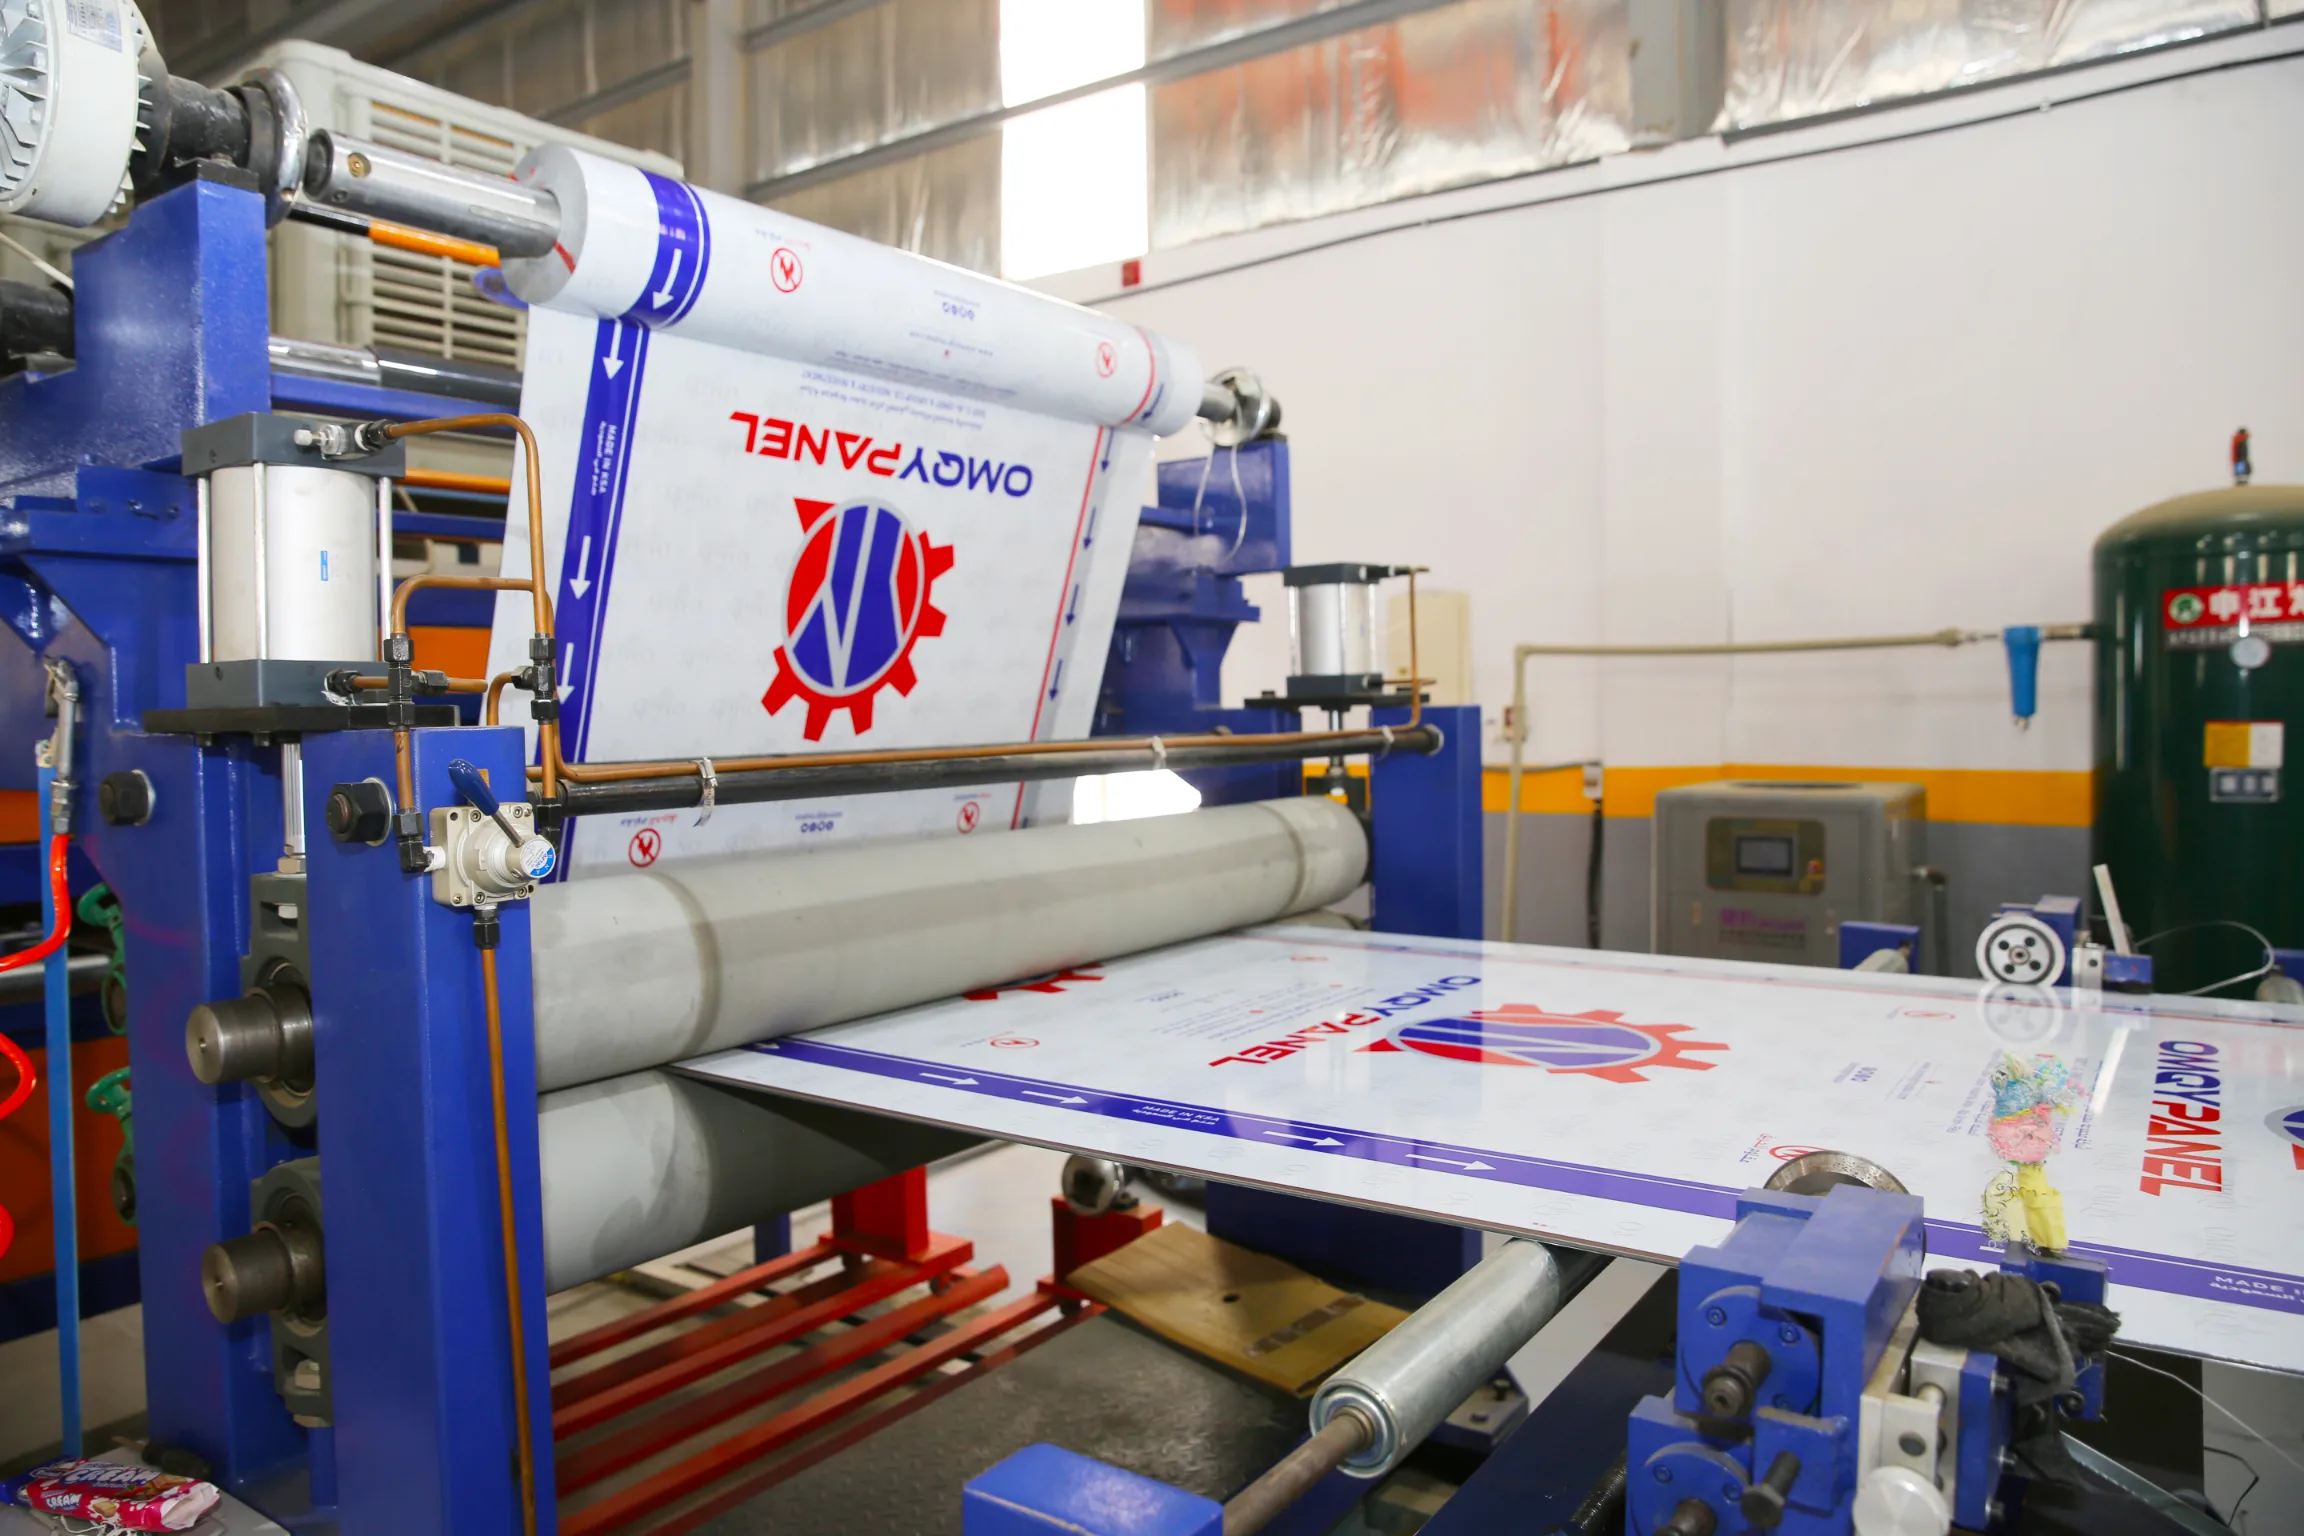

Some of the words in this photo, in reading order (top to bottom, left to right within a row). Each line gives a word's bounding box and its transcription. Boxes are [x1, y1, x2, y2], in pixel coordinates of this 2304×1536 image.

[604, 424, 617, 456] MADE
[729, 410, 1033, 497] OMQYPANEL
[602, 457, 612, 470] IN
[598, 471, 609, 493] KSA
[1208, 975, 1482, 1067] OMQYPANEL
[1141, 1105, 1178, 1114] MADE
[1194, 1114, 1220, 1122] KSA
[2215, 1275, 2284, 1293] MADE
[63, 1467, 160, 1485] CREAM
[46, 1493, 82, 1508] CREAM
